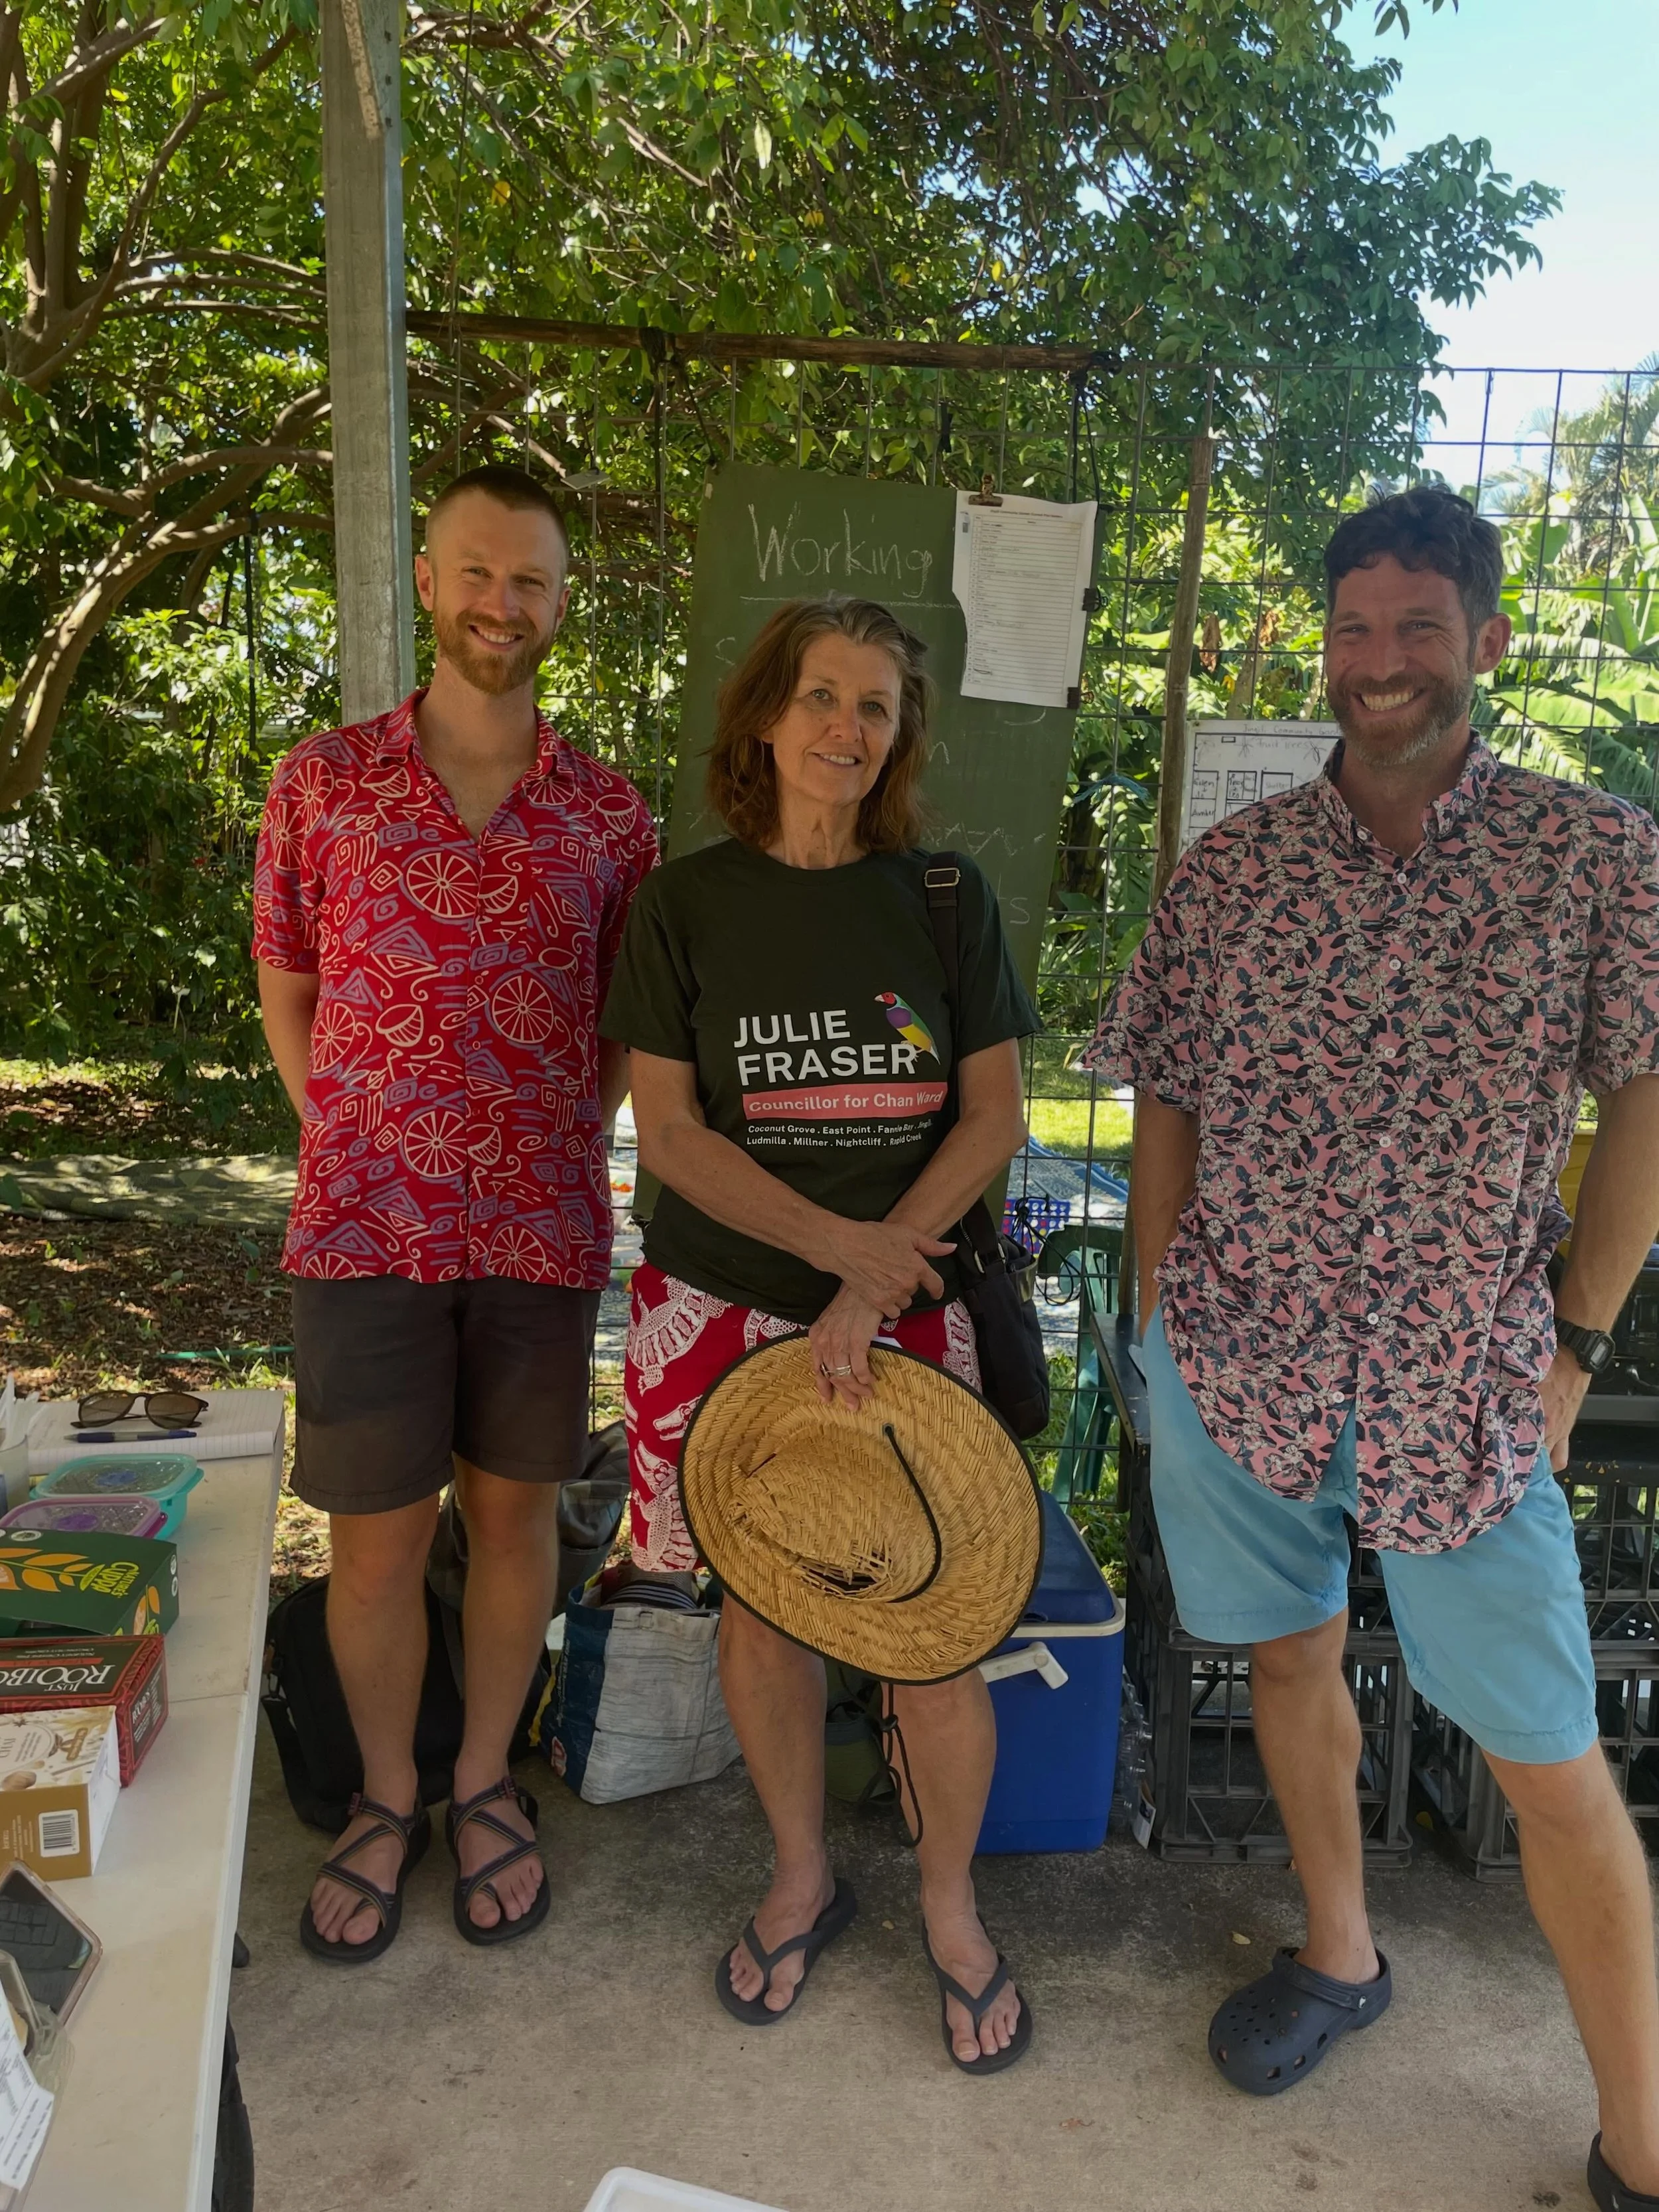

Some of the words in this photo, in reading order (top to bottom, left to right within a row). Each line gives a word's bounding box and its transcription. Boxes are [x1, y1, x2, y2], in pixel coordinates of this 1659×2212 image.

[748, 501, 932, 598] Working
[1273, 725, 1313, 735] Community
[734, 1009, 851, 1049] JULIE
[737, 1043, 916, 1086] FRASER
[749, 1096, 838, 1112] Councillor
[843, 1094, 869, 1109] for
[874, 1093, 913, 1108] Chan
[916, 1090, 944, 1106] Ward
[747, 1136, 786, 1145] Ludmilla
[794, 1138, 829, 1147] Millner
[835, 1138, 882, 1148] Nightcliff
[890, 1134, 906, 1145] Rapid
[906, 1132, 922, 1142] Creek
[748, 1125, 785, 1134] Coconut
[787, 1125, 816, 1134] Grove
[822, 1126, 844, 1135] East
[846, 1126, 871, 1135] Point
[878, 1124, 902, 1134] Fannie
[903, 1124, 914, 1132] Bay
[91, 1562, 139, 1593] CUPPA
